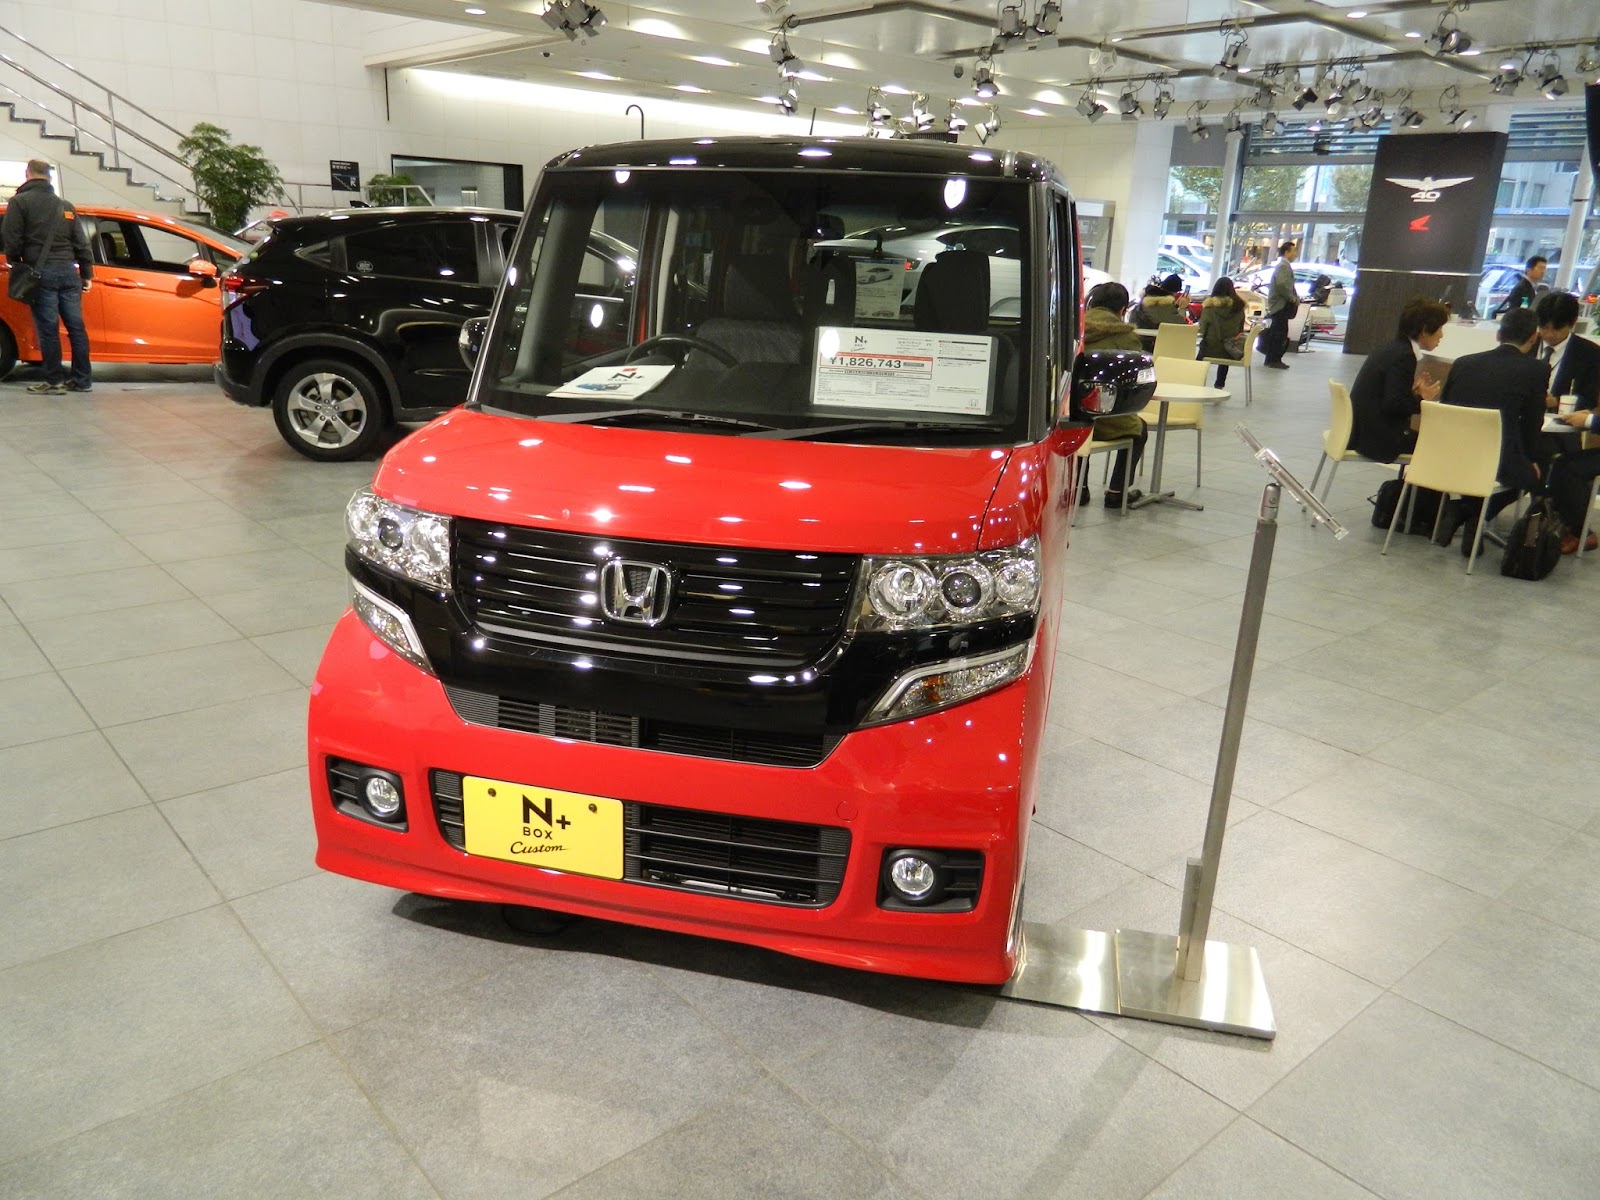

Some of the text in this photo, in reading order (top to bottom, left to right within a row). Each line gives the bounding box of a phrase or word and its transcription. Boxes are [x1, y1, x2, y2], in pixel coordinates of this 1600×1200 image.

[829, 355, 902, 369] ¥1,826,743
[522, 826, 553, 840] BOX
[510, 841, 568, 855] Custom
